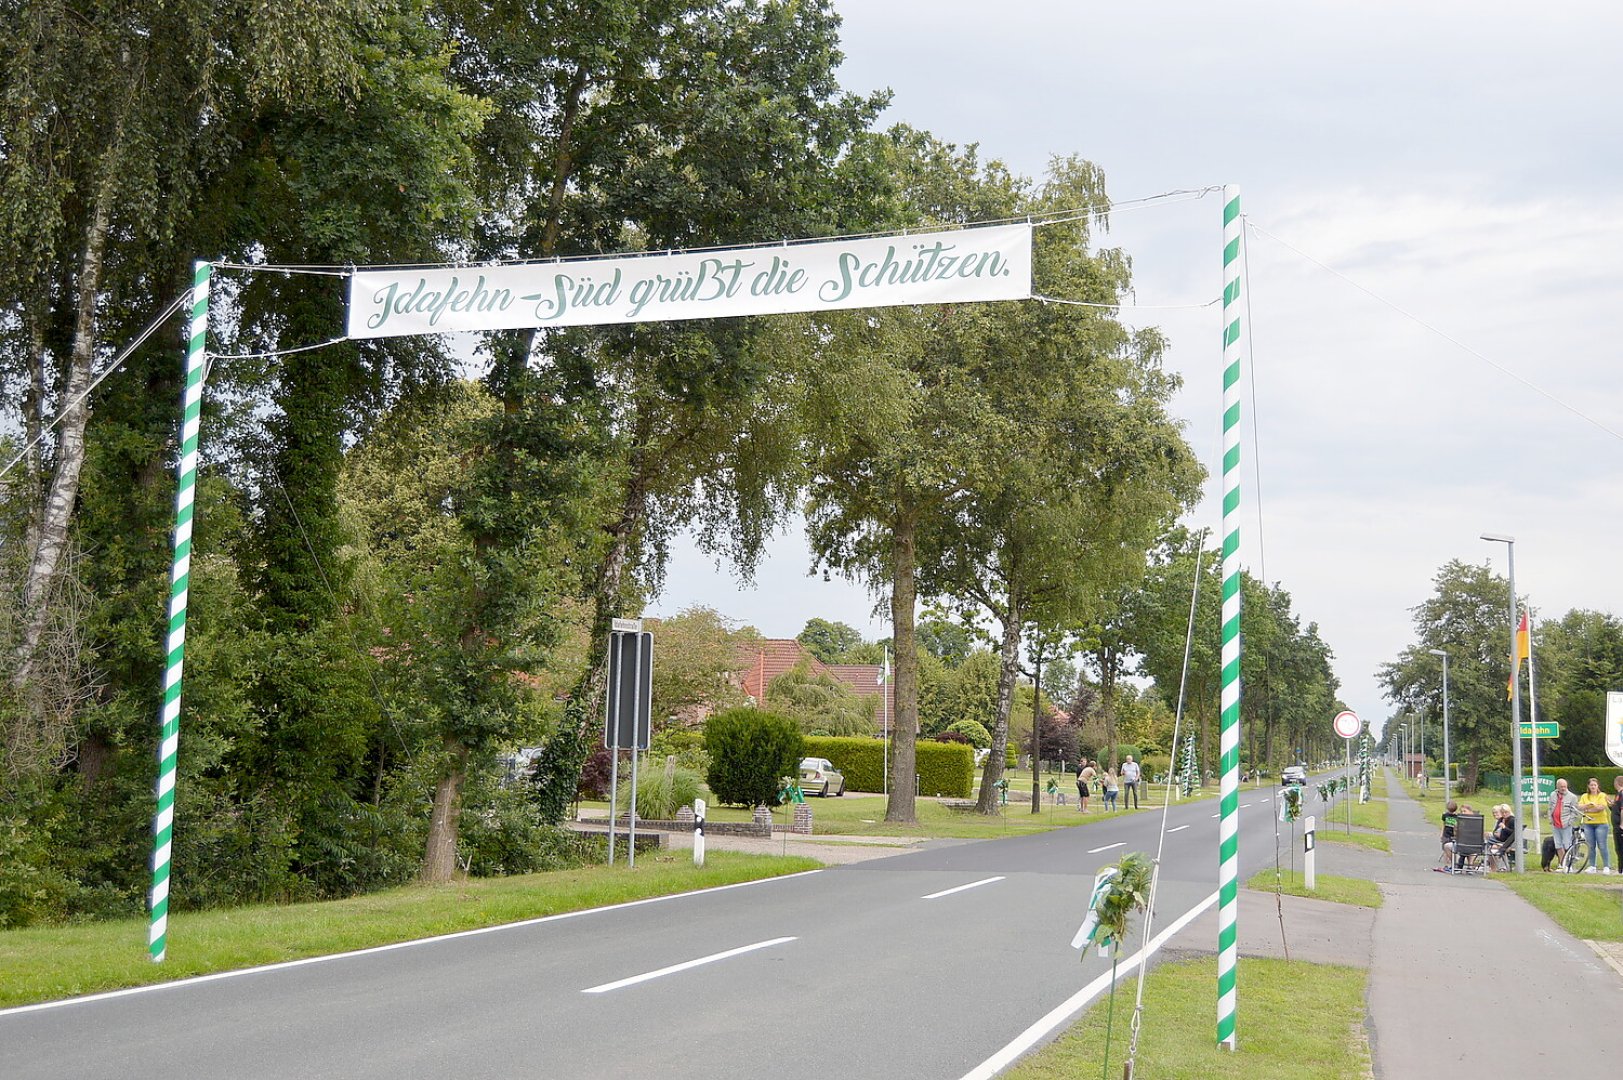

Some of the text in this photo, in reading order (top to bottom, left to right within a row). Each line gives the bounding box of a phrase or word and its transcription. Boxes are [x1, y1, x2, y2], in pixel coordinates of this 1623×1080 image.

[626, 258, 756, 317] grüßt
[751, 256, 809, 297] die
[818, 241, 1010, 302] Schützen.
